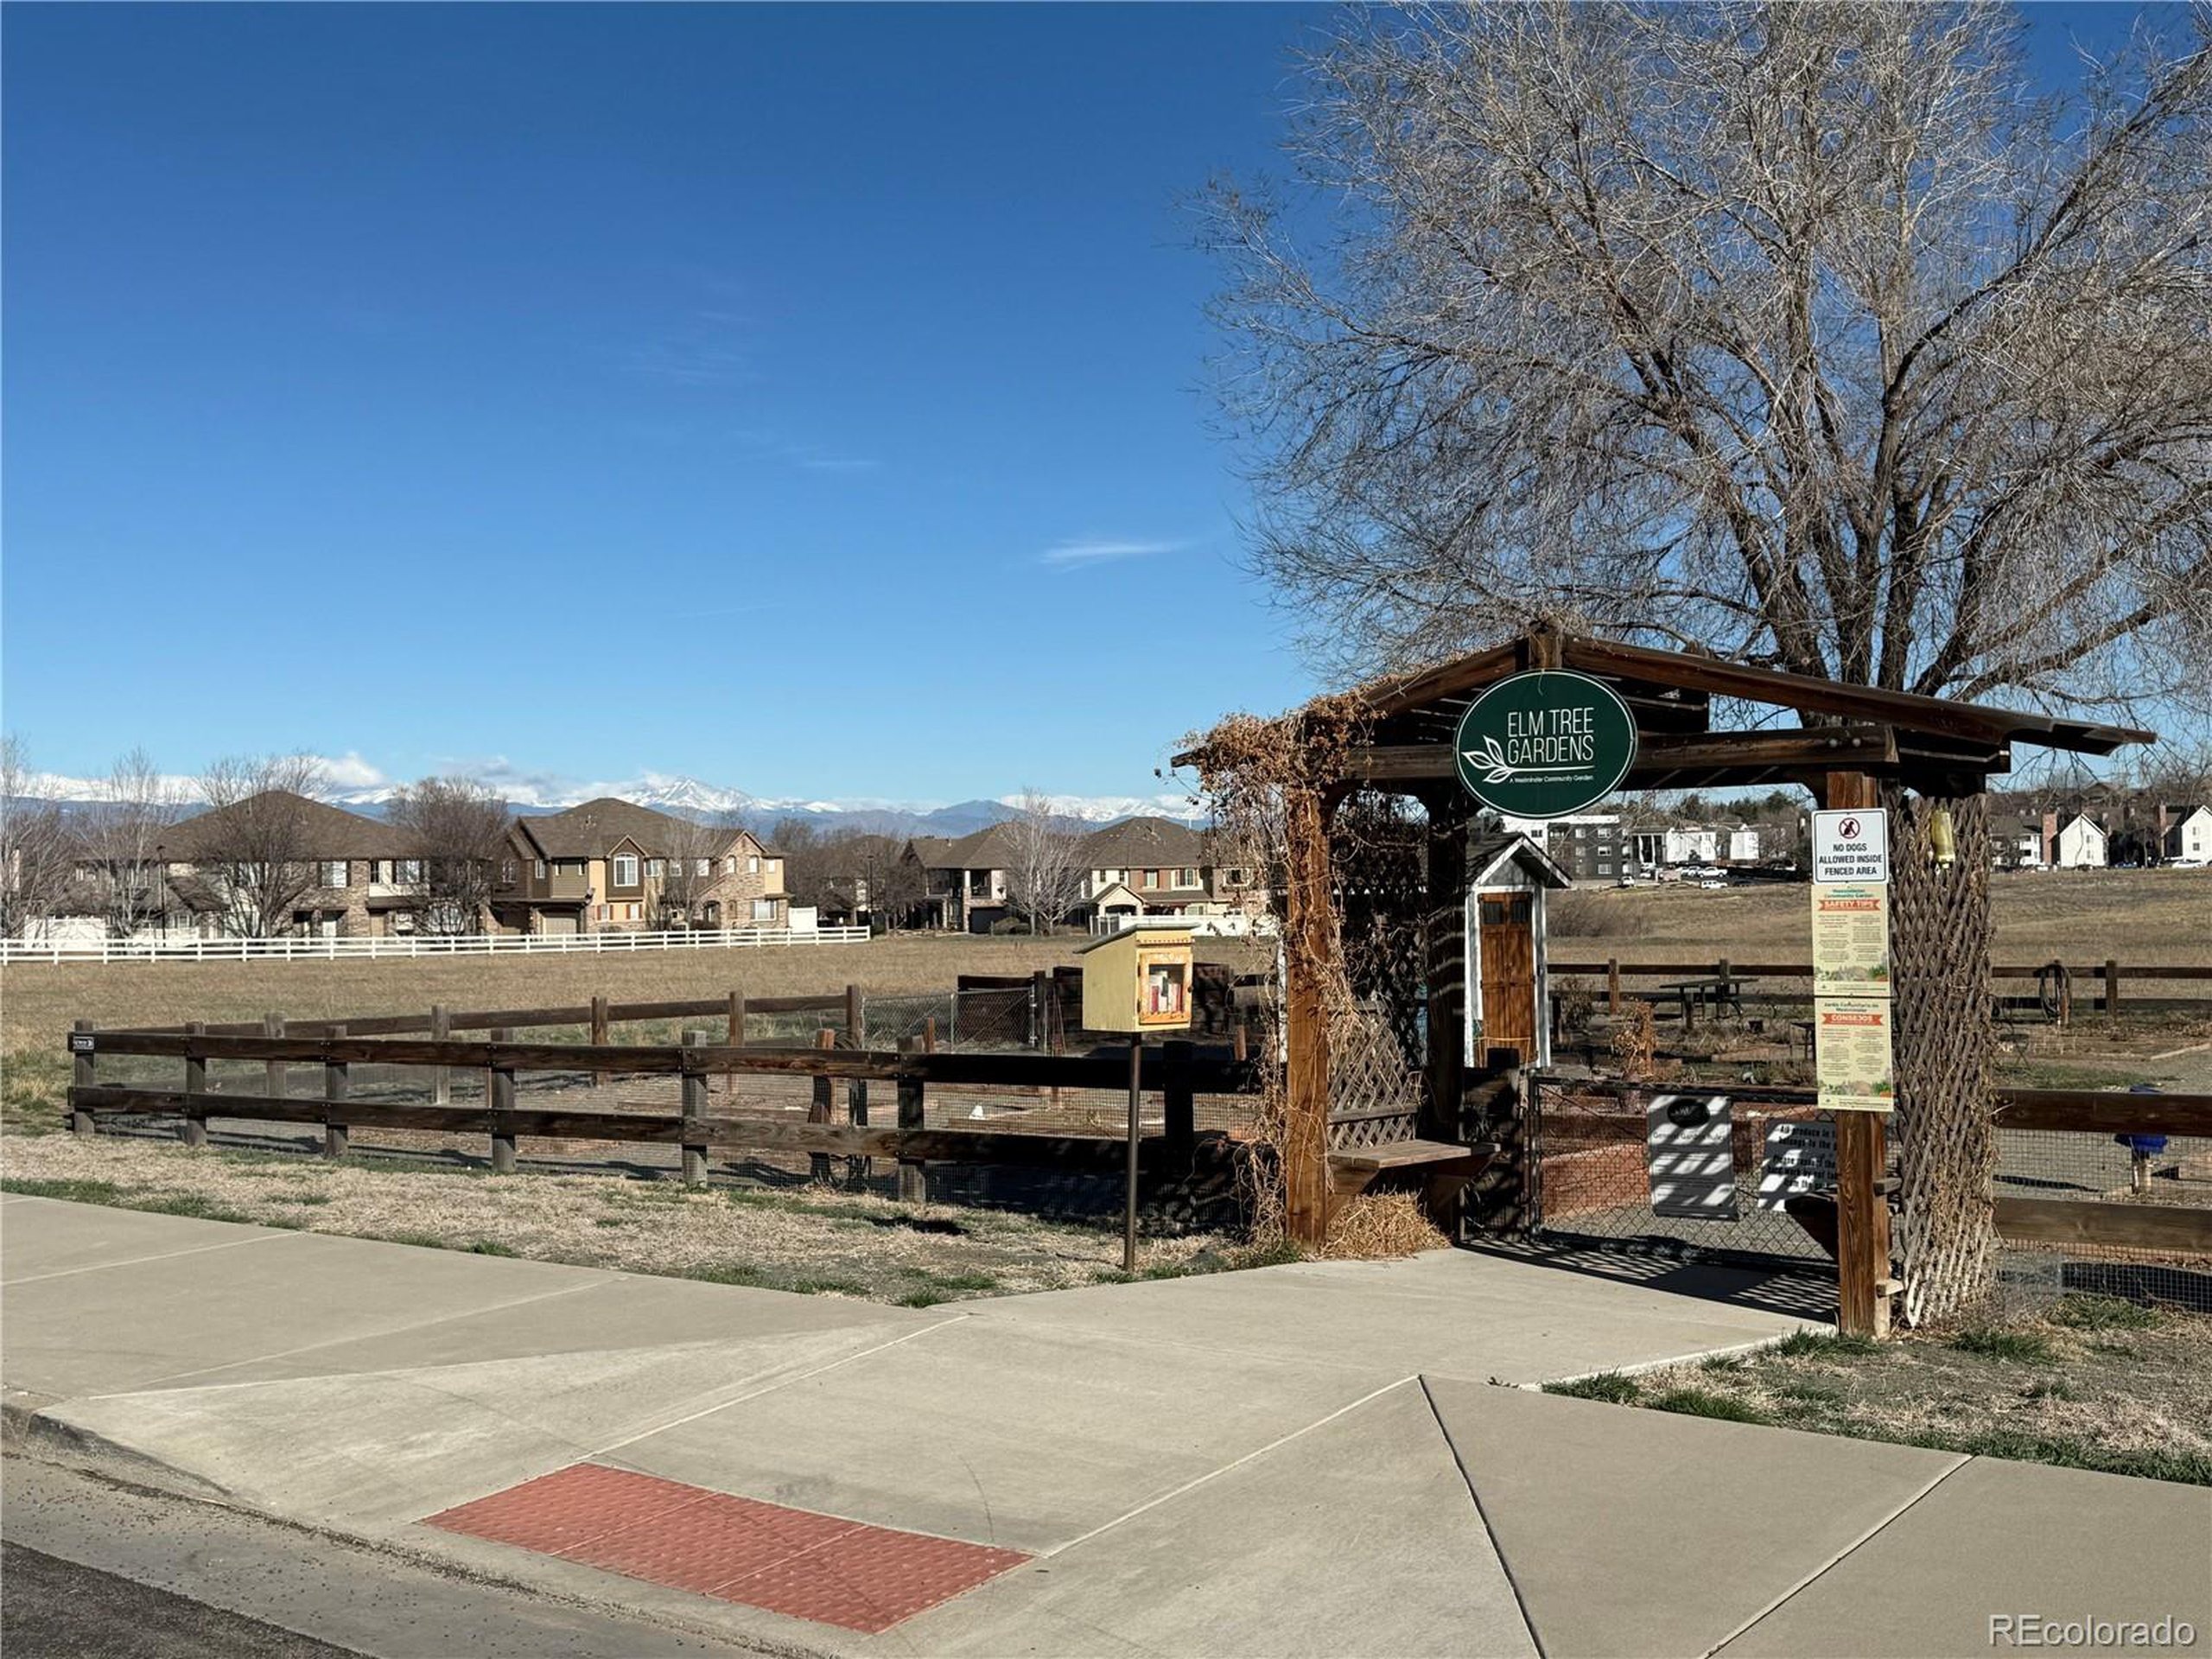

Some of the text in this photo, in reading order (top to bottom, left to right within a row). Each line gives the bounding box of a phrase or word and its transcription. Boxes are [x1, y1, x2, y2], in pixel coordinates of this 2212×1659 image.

[1508, 707, 1594, 737] ELM TREE
[1507, 735, 1594, 765] GARDENS
[1543, 775, 1573, 784] Community
[1833, 842, 1867, 852] NO DOGS
[1819, 854, 1882, 864] ALLOWED INSIDE
[1825, 866, 1878, 875] FENCED AREA
